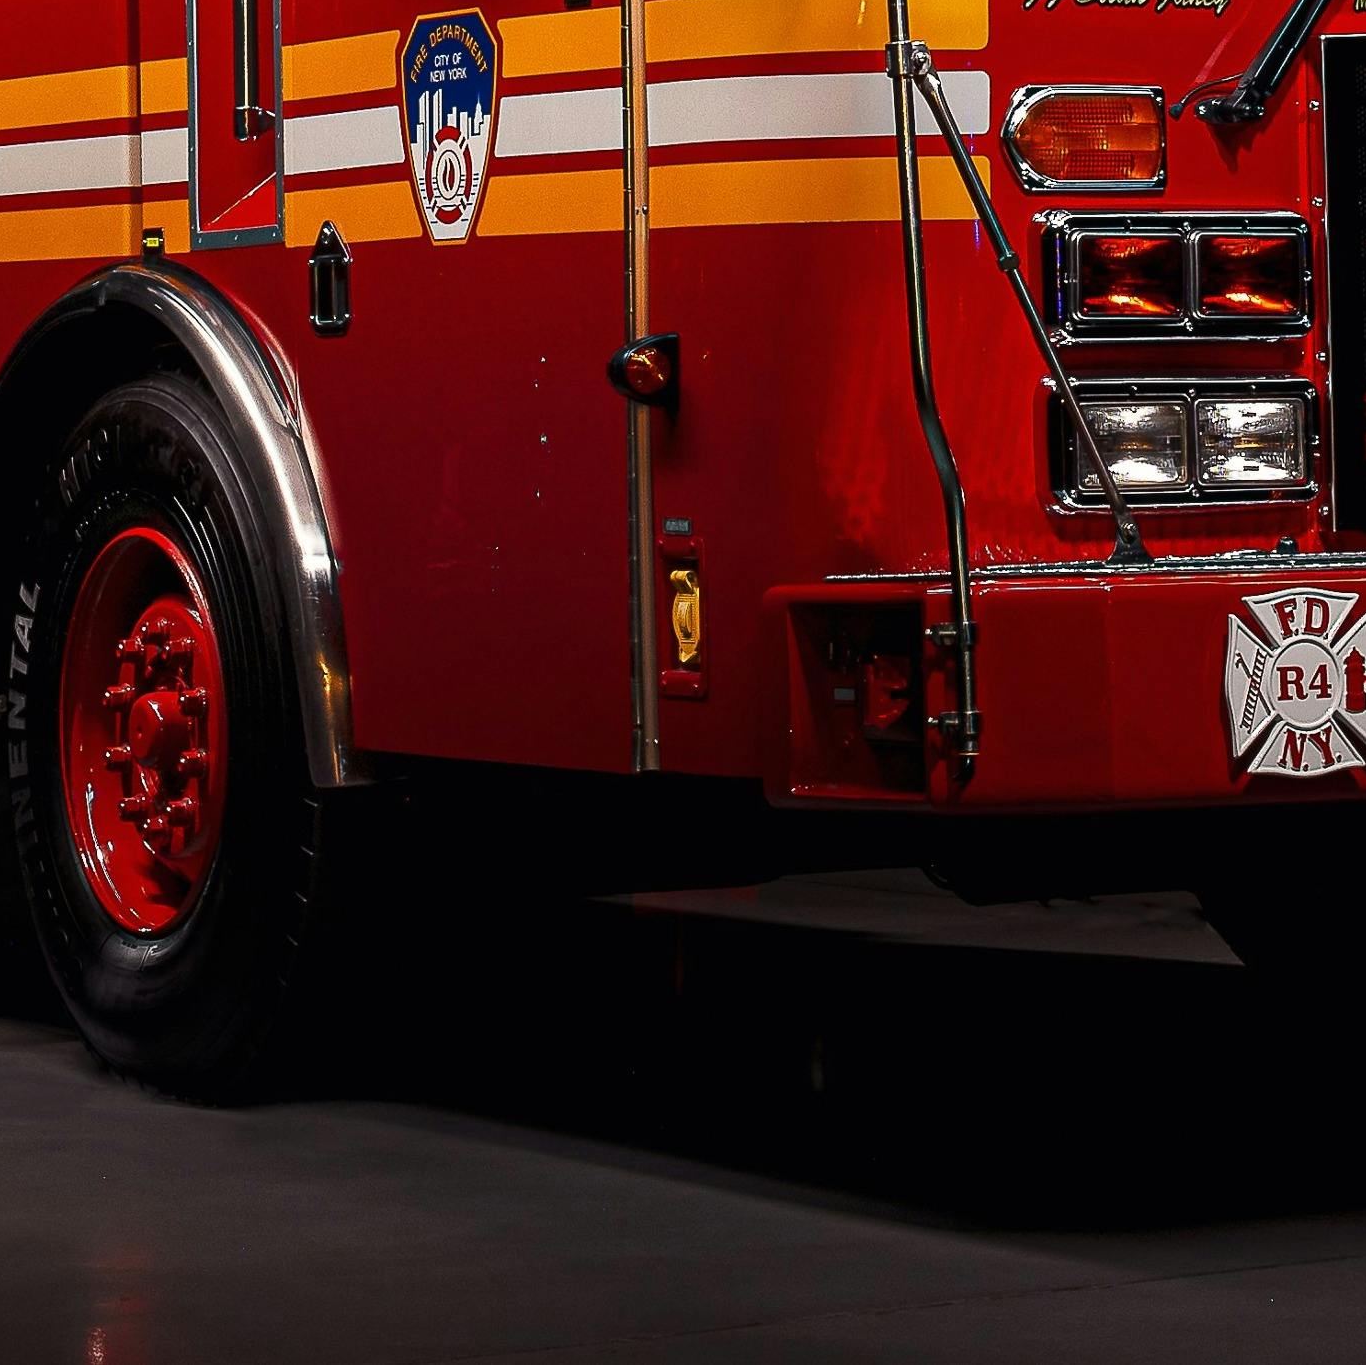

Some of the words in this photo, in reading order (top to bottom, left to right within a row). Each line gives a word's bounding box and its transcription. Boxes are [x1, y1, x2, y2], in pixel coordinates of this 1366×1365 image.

[409, 44, 428, 84] FIRE
[429, 24, 488, 73] DEPARTMENT
[434, 53, 450, 68] CITY
[452, 52, 462, 65] OF
[430, 70, 445, 83] NEW
[448, 67, 467, 80] YORK
[1276, 664, 1332, 702] R4
[1278, 725, 1342, 771] N.Y.
